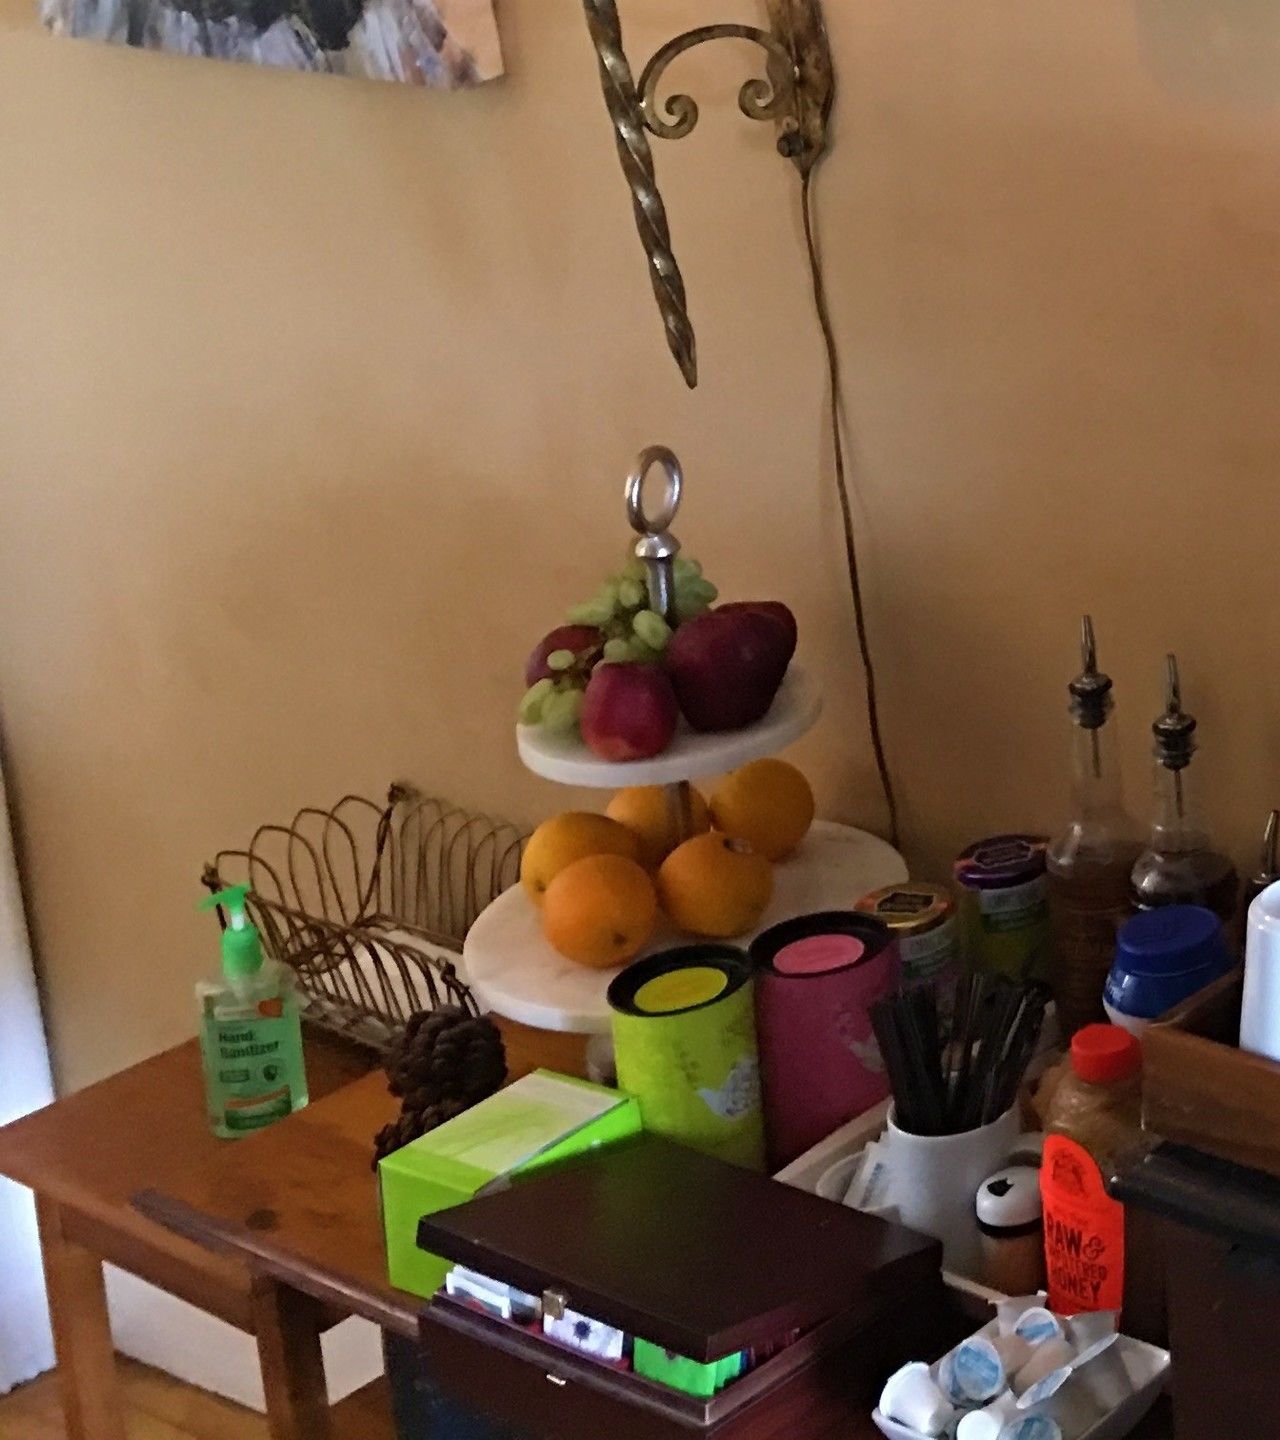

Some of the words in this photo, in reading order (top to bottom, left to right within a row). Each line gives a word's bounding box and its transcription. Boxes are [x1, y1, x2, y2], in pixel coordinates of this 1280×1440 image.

[218, 1030, 254, 1043] Hand
[219, 1041, 280, 1059] Sanitizer
[1046, 1212, 1083, 1258] RAW
[1083, 1235, 1106, 1261] &
